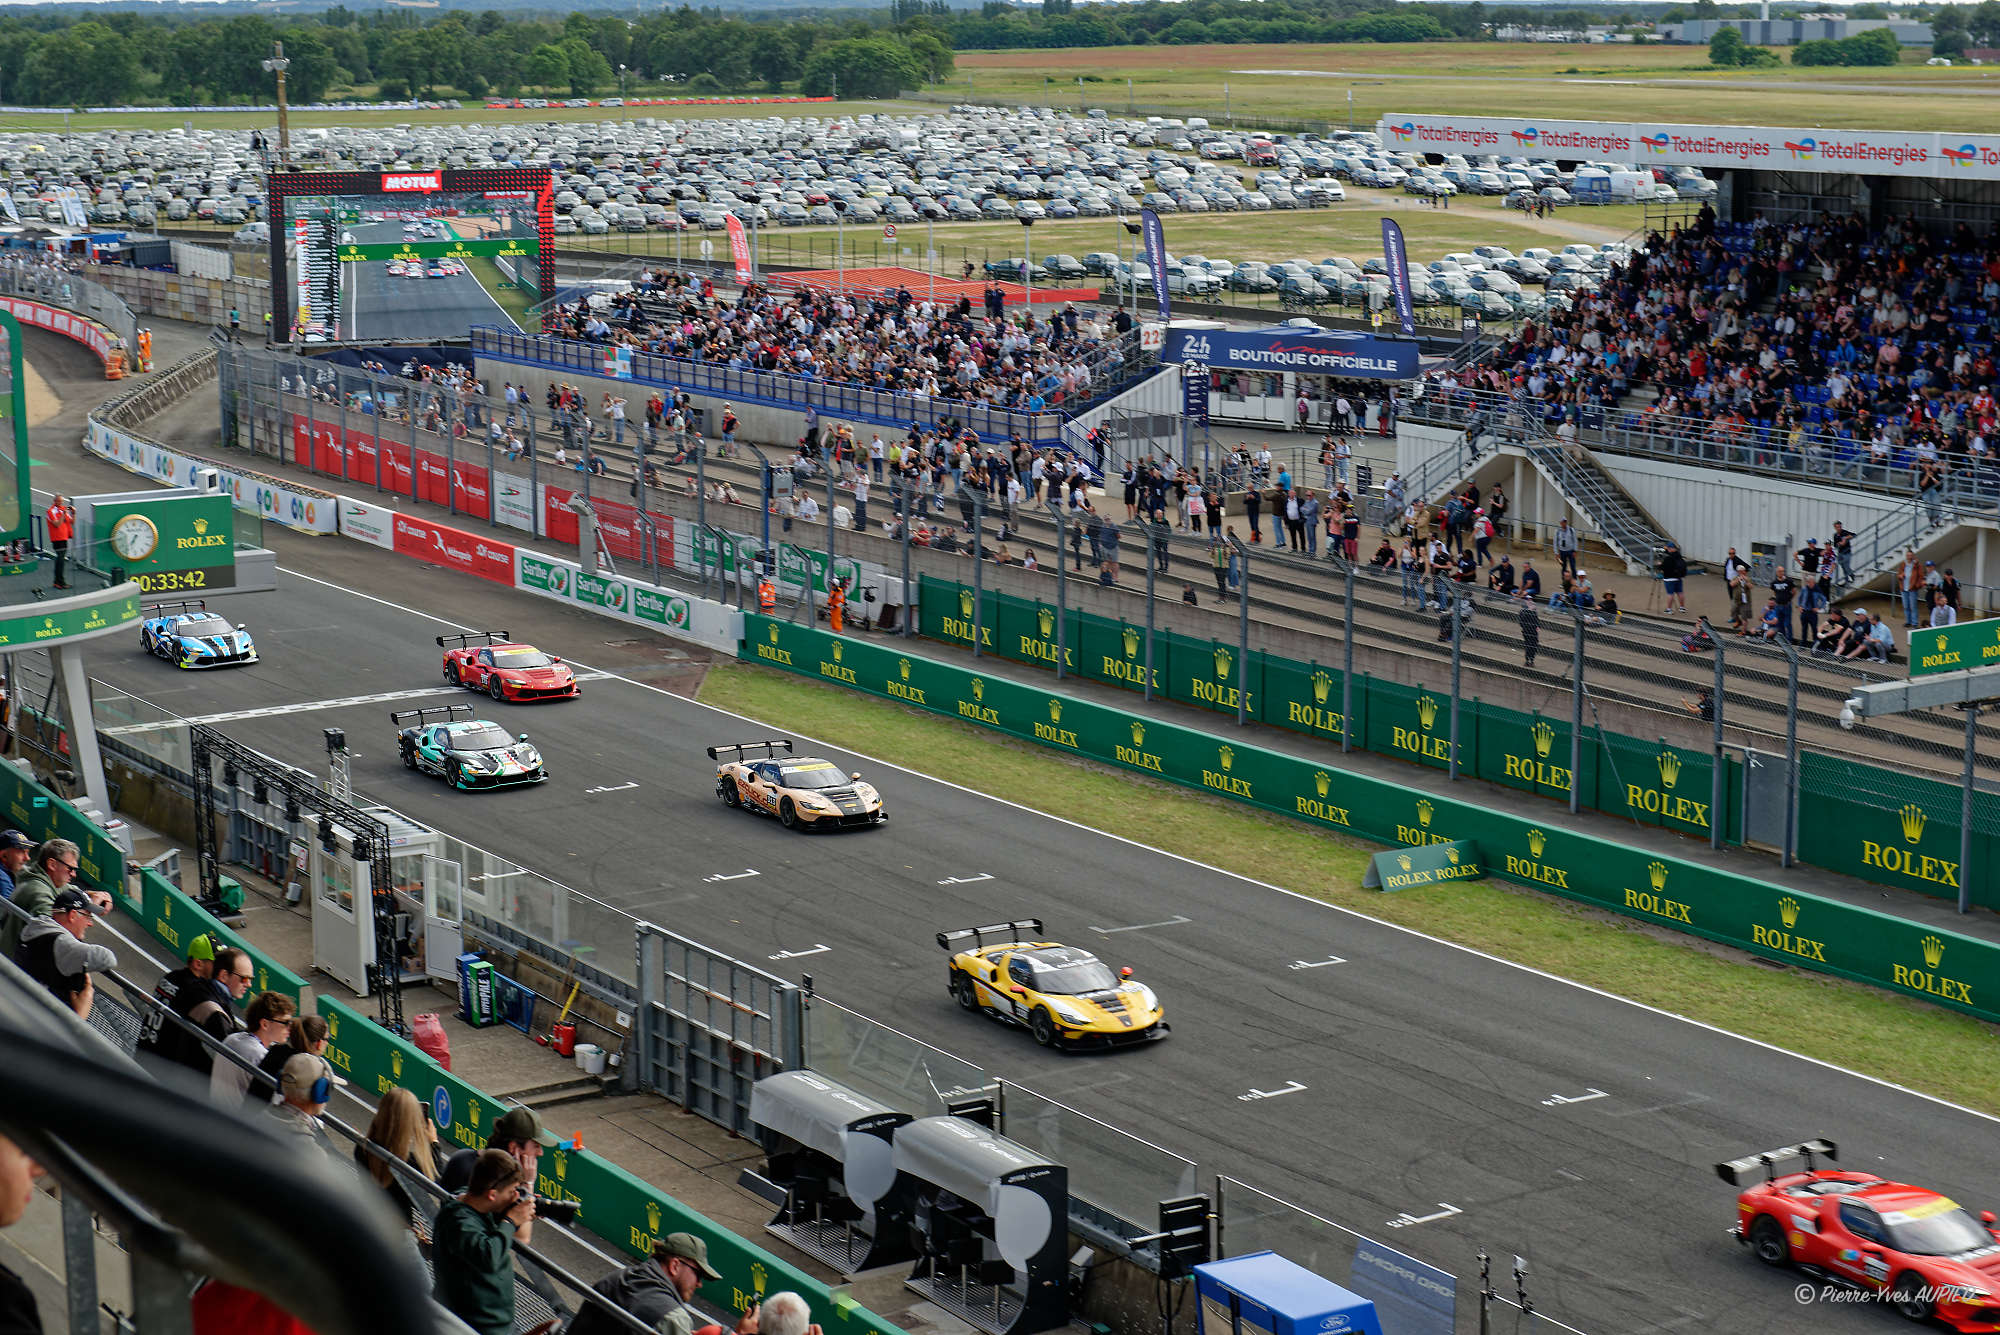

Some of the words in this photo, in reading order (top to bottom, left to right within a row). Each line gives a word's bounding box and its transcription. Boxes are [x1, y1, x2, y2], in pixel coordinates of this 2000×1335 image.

[1416, 124, 1498, 147] TotalEnergies
[1539, 130, 1630, 153] TotalEnergies
[1670, 135, 1770, 159] TotalEnergies
[1818, 141, 1927, 165] TotalEnergies
[385, 175, 439, 189] MOTUL
[1229, 348, 1307, 366] BOUTIQUE
[1308, 354, 1398, 372] OFFICIELLE
[176, 535, 226, 549] ROLEX
[522, 559, 548, 580] Sarthe
[577, 574, 603, 594] Sarthe
[636, 590, 664, 613] Sarthe
[35, 628, 63, 639] ROLEX
[757, 643, 793, 666] ROLEX
[1921, 651, 1961, 668] ROLEX
[820, 661, 857, 684] ROLEX
[886, 679, 927, 705] ROLEX
[958, 700, 1000, 726] ROLEX
[1033, 721, 1079, 749] ROLEX
[1115, 744, 1164, 773] ROLEX
[1202, 769, 1254, 799] ROLEX
[1295, 795, 1351, 827] ROLEX
[1626, 783, 1711, 828] ROLEX
[1386, 871, 1433, 888] ROLEX
[1435, 863, 1480, 881] ROLEX
[1505, 854, 1570, 889] ROLEX
[1862, 840, 1960, 888] ROLEX
[1624, 887, 1693, 925] ROLEX
[156, 917, 181, 950] ROLEX
[1752, 923, 1827, 963] ROLEX
[1892, 963, 1973, 1006] ROLEX
